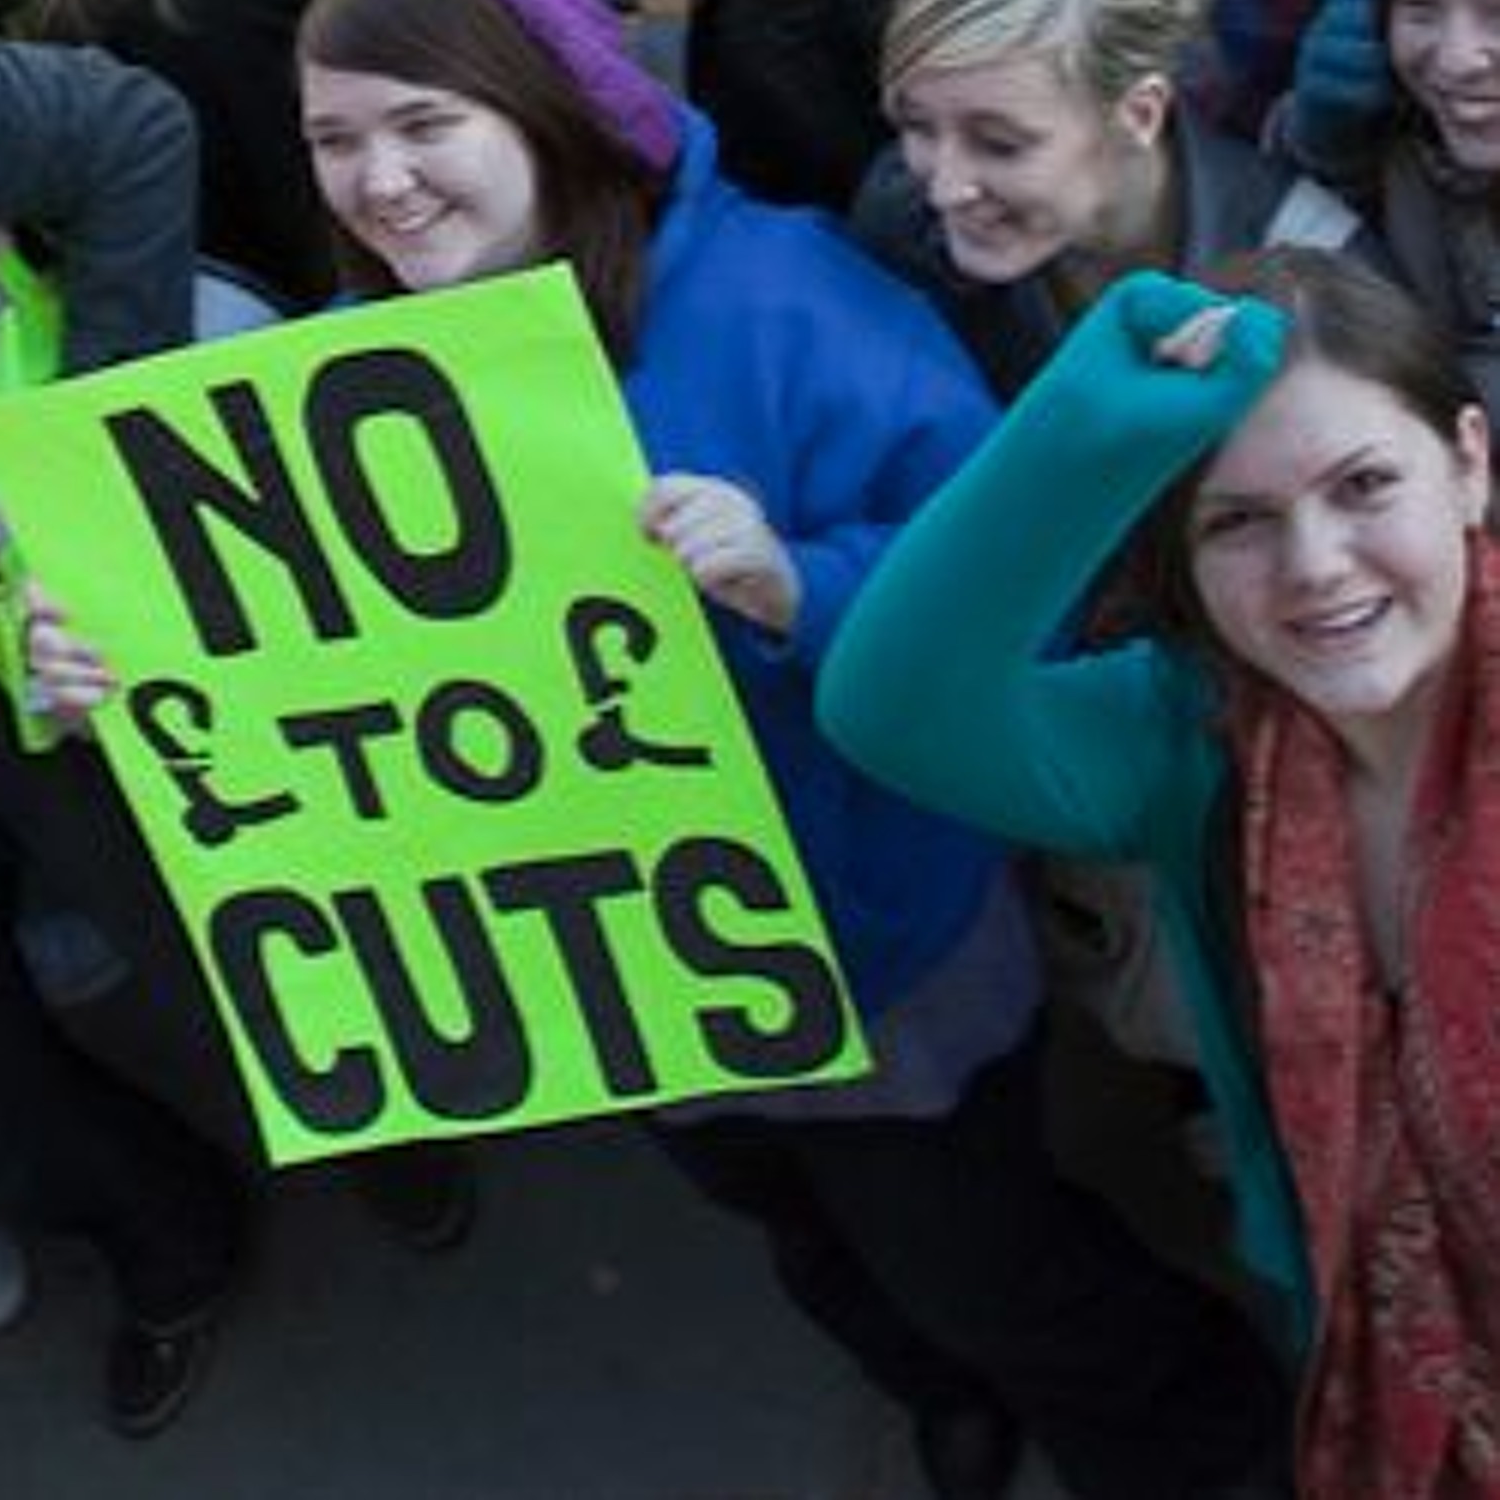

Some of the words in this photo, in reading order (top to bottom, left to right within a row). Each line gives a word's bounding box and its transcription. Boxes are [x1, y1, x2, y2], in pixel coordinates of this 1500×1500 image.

[103, 346, 514, 658] NO
[126, 678, 300, 849] £
[277, 680, 545, 822] TO
[564, 595, 712, 774] £
[208, 835, 846, 1135] CUTS
